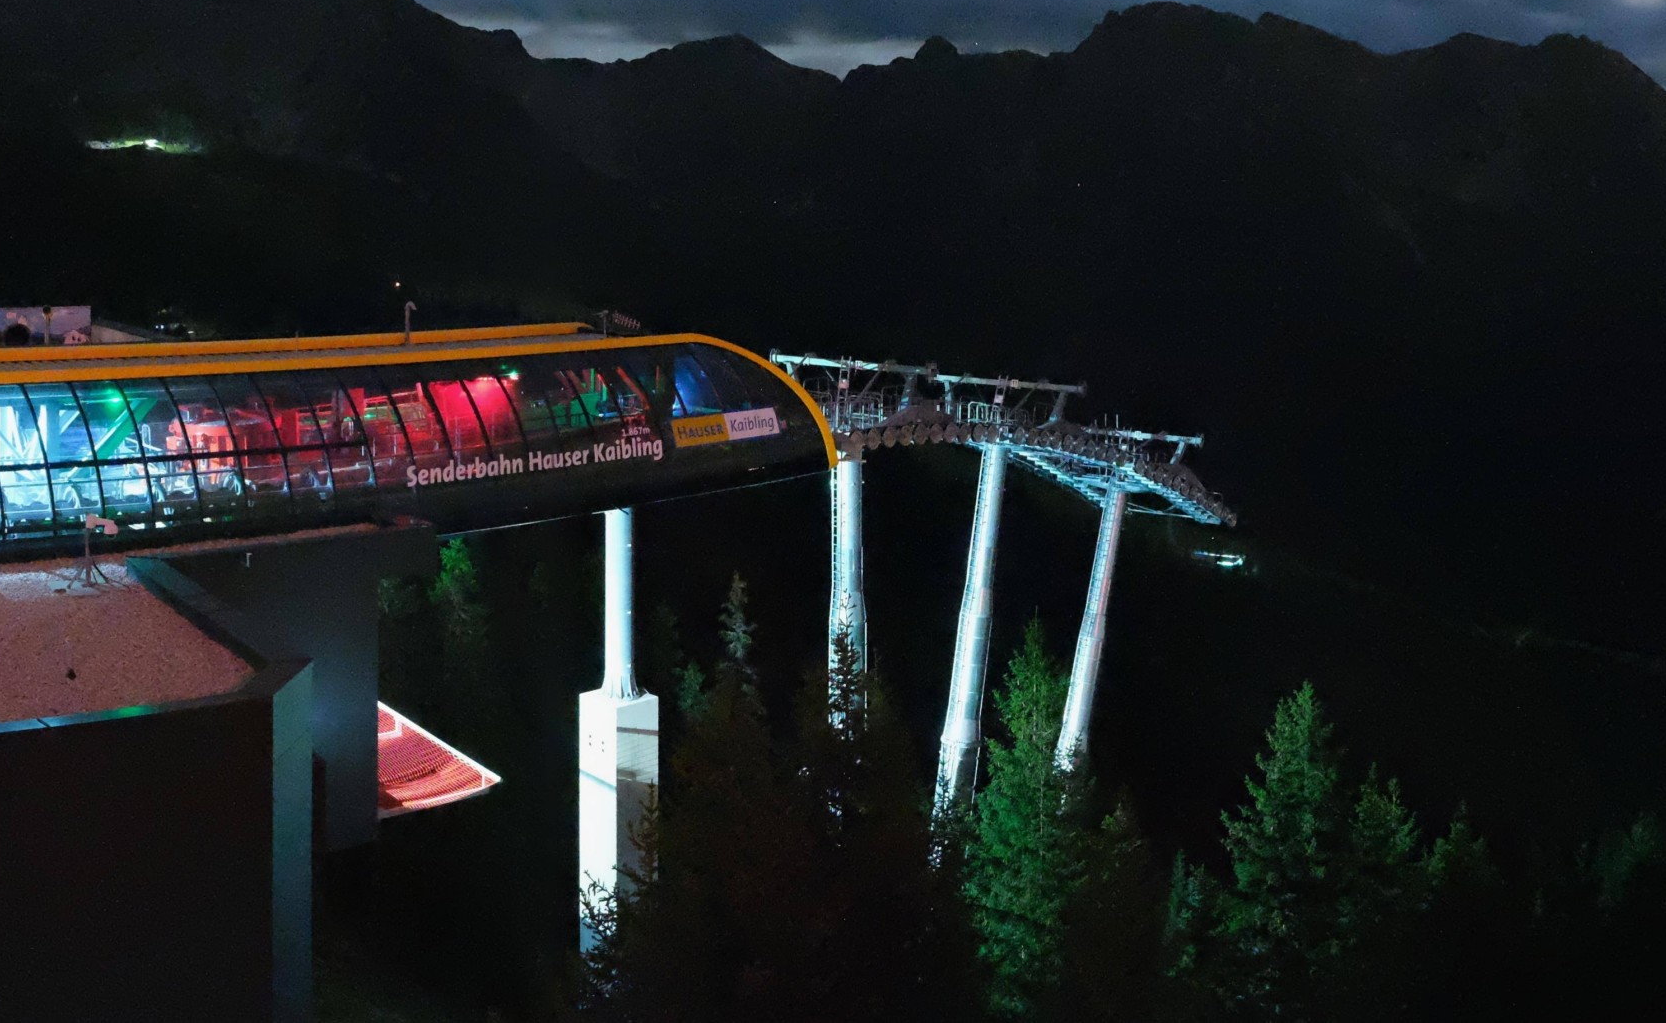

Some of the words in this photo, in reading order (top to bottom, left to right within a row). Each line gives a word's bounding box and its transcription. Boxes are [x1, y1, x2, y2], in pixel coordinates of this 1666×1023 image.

[678, 421, 725, 440] HAUSER
[730, 412, 775, 435] Kaibling
[406, 452, 524, 488] Senderbahn
[529, 444, 588, 473] Hauser
[593, 435, 664, 463] Kaibling
